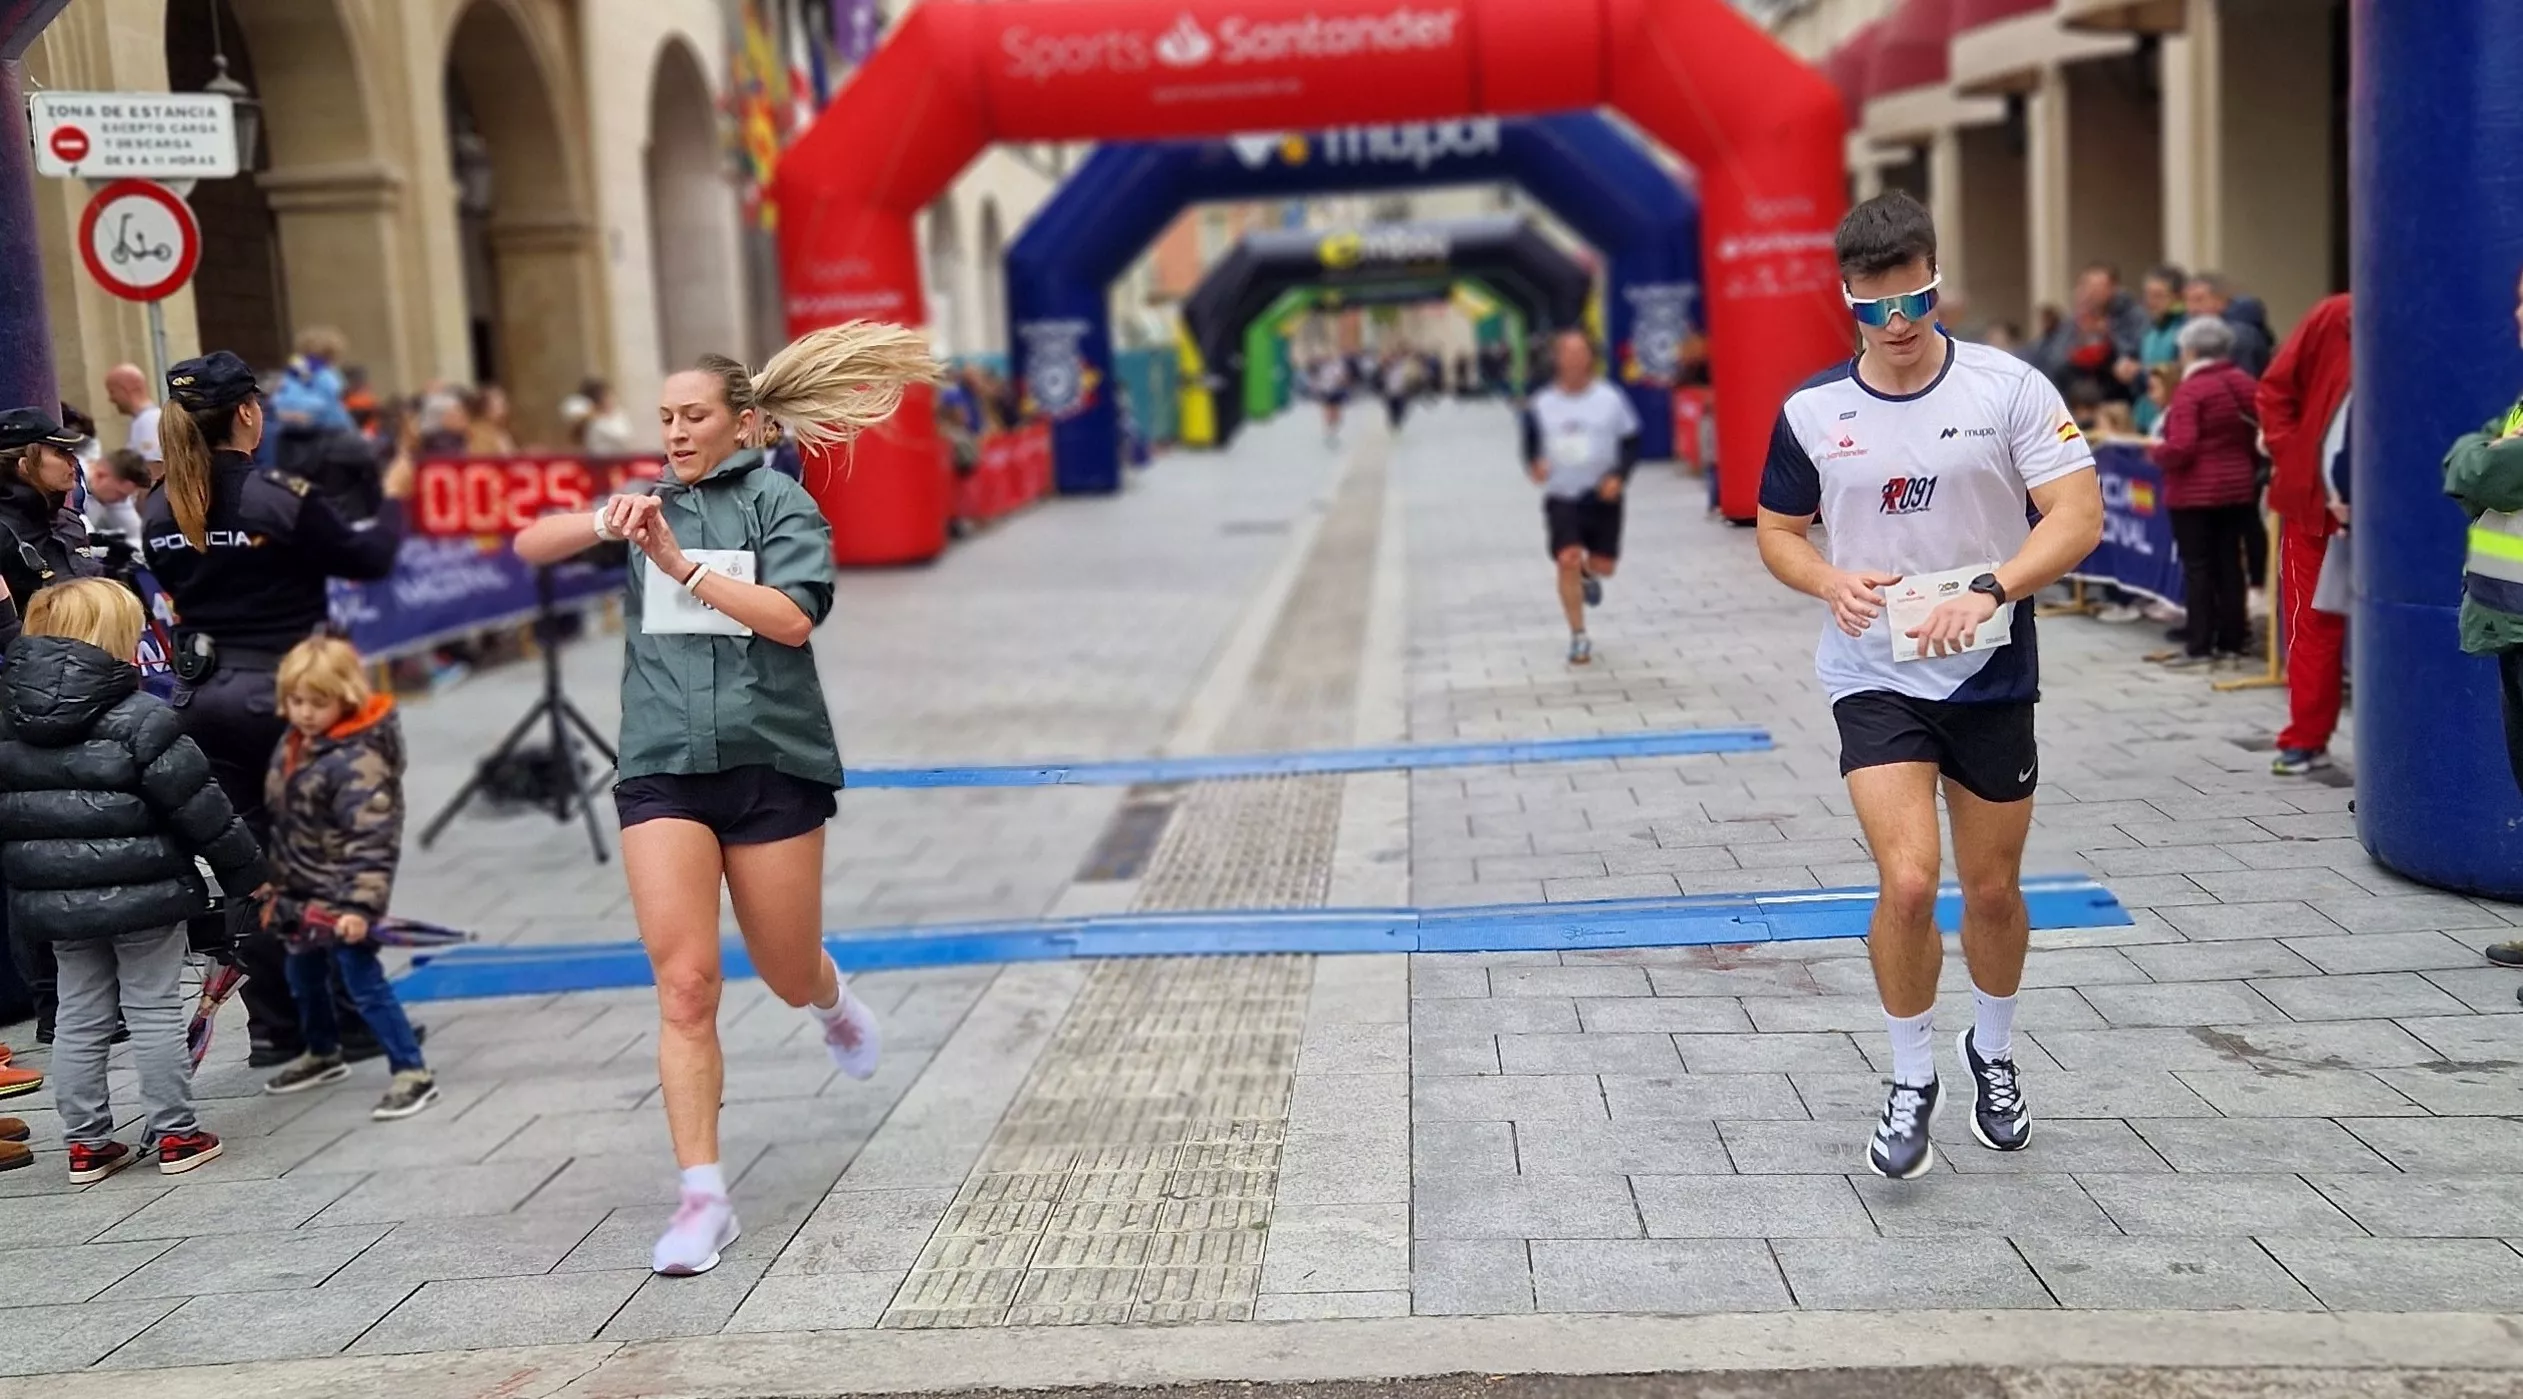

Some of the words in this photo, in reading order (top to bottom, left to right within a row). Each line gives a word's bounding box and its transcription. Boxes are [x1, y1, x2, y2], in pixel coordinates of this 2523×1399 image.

[1002, 26, 1148, 86] Sports
[1219, 7, 1456, 64] Santander
[47, 105, 96, 117] ZONA
[102, 105, 122, 117] DE
[129, 104, 217, 118] ESTANCIA
[101, 123, 165, 134] EXCEPTO
[170, 122, 217, 134] CARGA
[116, 138, 192, 149] DESCARGA
[104, 154, 122, 165] DE
[169, 154, 216, 165] HORAS
